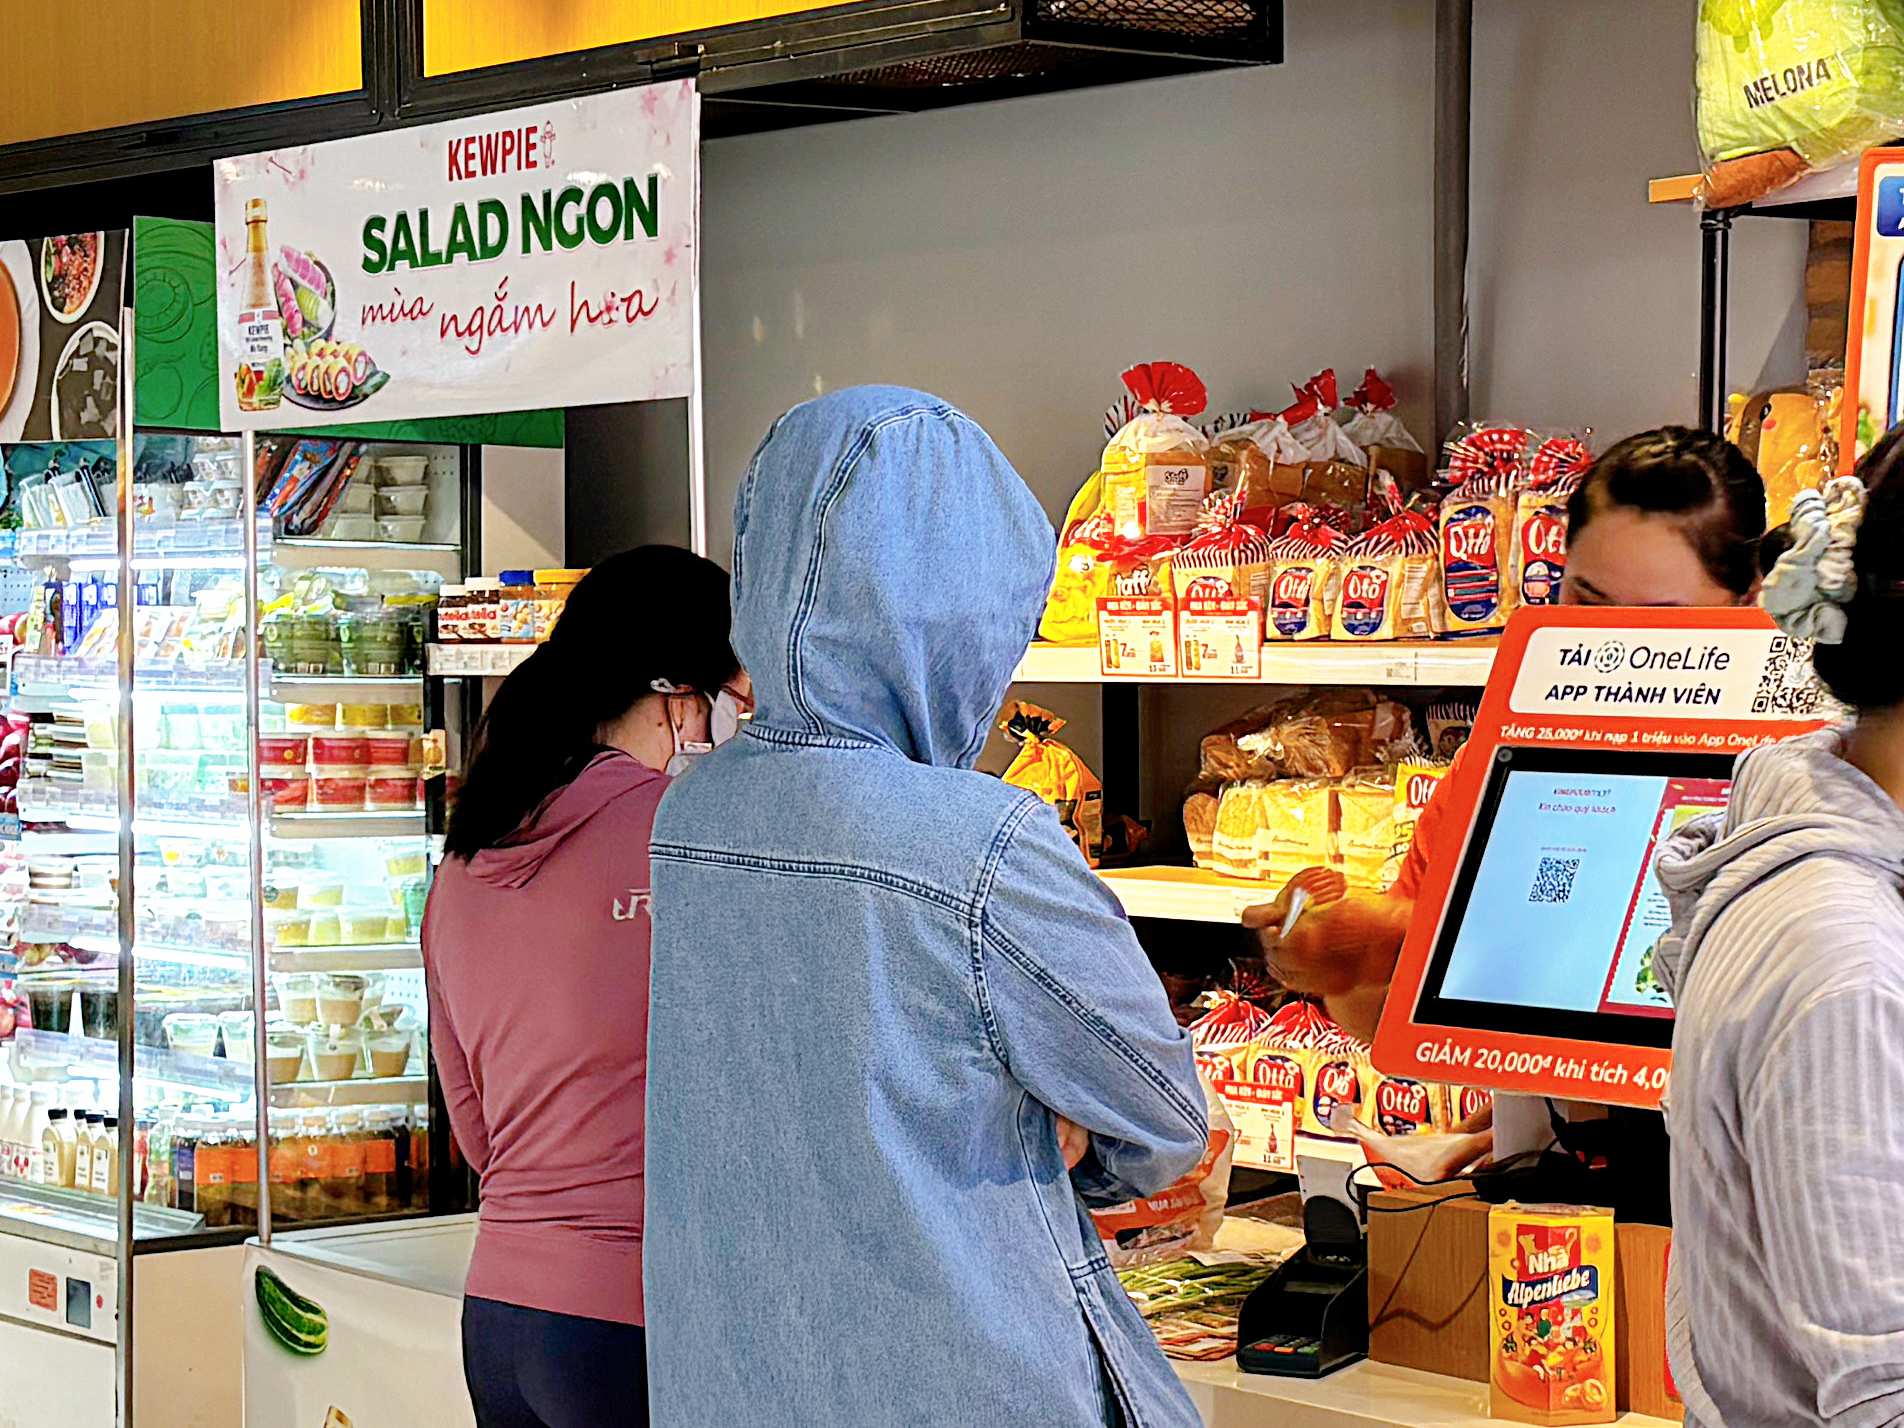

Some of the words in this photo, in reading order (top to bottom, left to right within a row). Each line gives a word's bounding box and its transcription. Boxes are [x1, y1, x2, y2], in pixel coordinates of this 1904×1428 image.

[1742, 62, 1832, 109] MELONA
[448, 126, 538, 181] KEWPIE
[362, 198, 509, 274] SALAD
[521, 174, 659, 255] NGON
[361, 288, 434, 327] mùa
[440, 276, 556, 355] ngắm
[1559, 644, 1590, 666] TẢI
[1630, 645, 1729, 670] OneLife
[1545, 685, 1587, 701] APP
[1595, 683, 1665, 703] THÀNH
[1672, 684, 1721, 704] VIÊN
[1415, 1039, 1471, 1066] GIẢM
[1554, 1056, 1585, 1080] khi
[1590, 1060, 1629, 1085] tích
[1382, 1087, 1419, 1114] Otto
[1506, 1268, 1591, 1307] Alpenliebe
